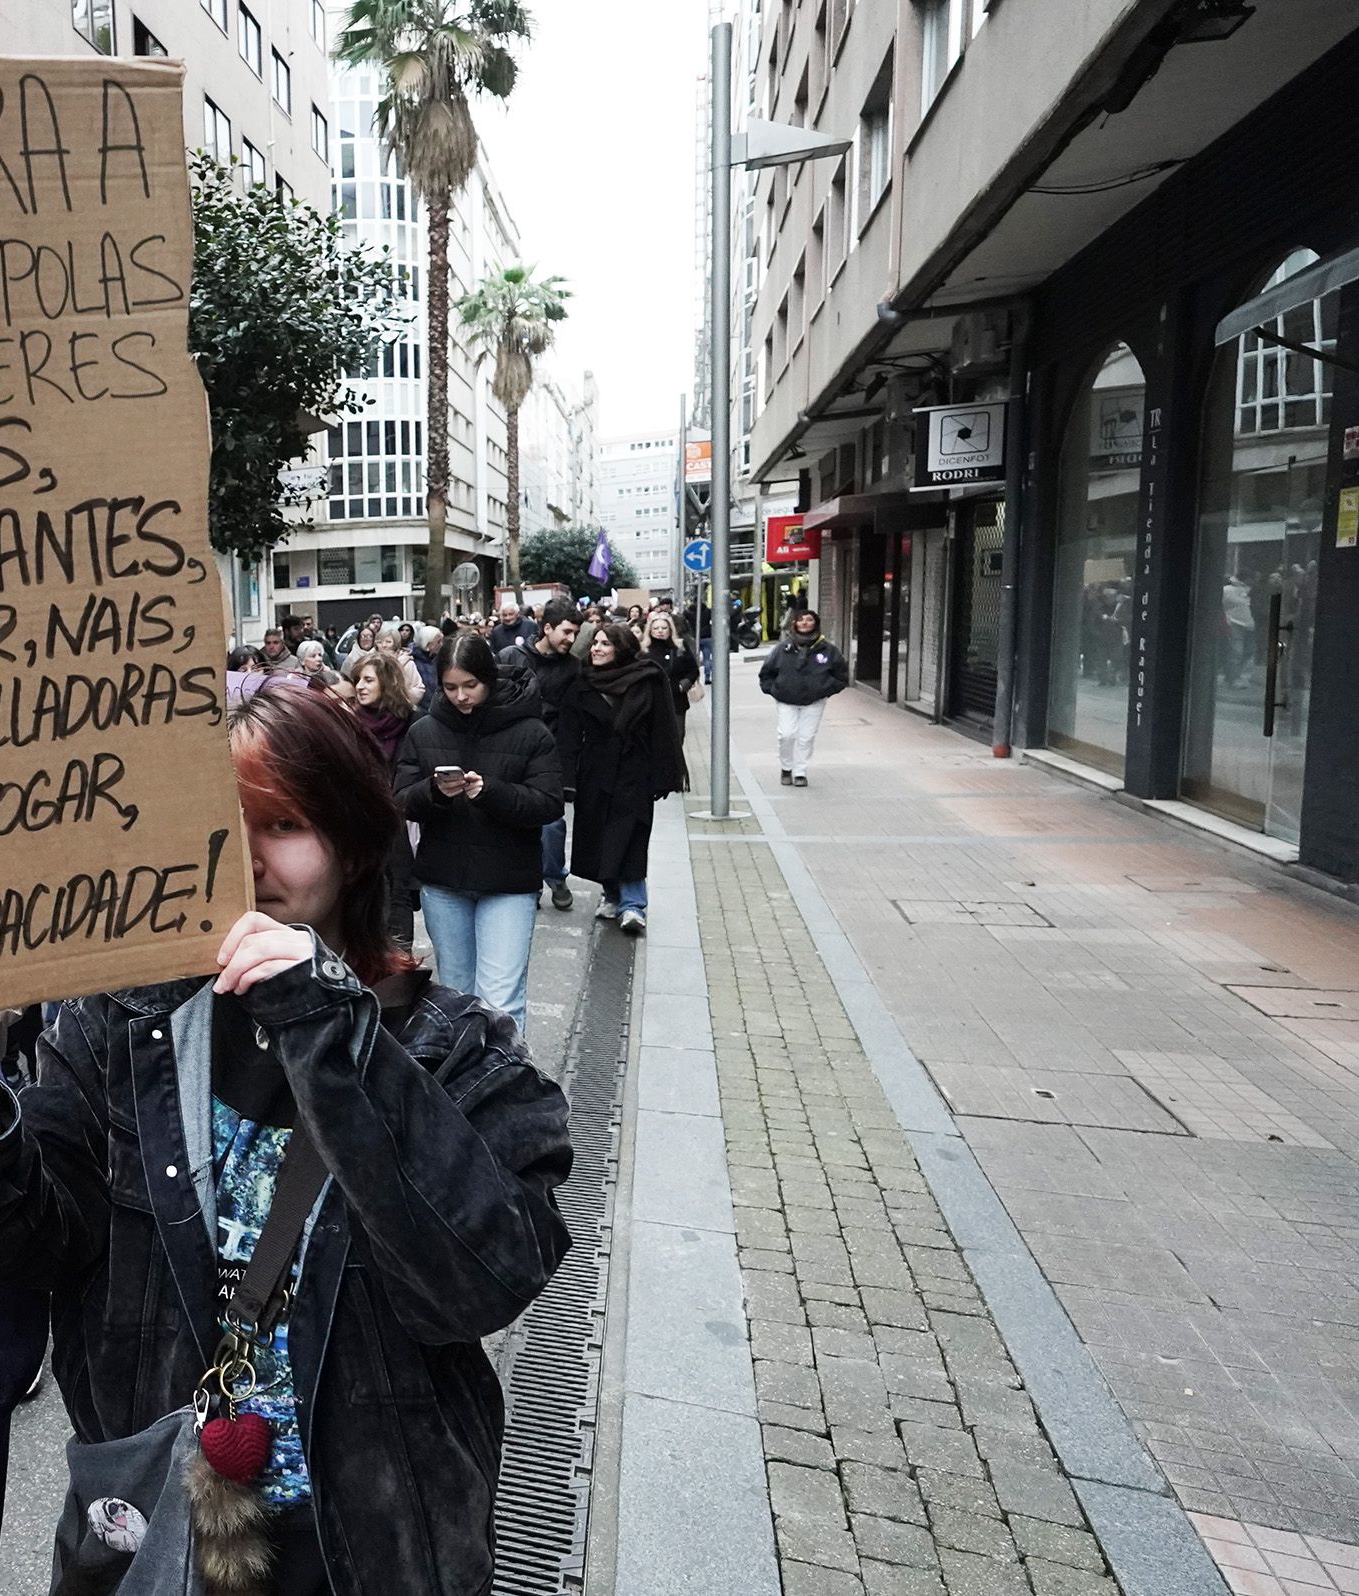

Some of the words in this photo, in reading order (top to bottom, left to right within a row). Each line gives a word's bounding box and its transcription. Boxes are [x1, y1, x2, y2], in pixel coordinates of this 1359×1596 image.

[97, 77, 151, 206] A
[0, 231, 184, 327] POLAS
[1150, 408, 1162, 428] TR
[932, 468, 979, 481] RODRI
